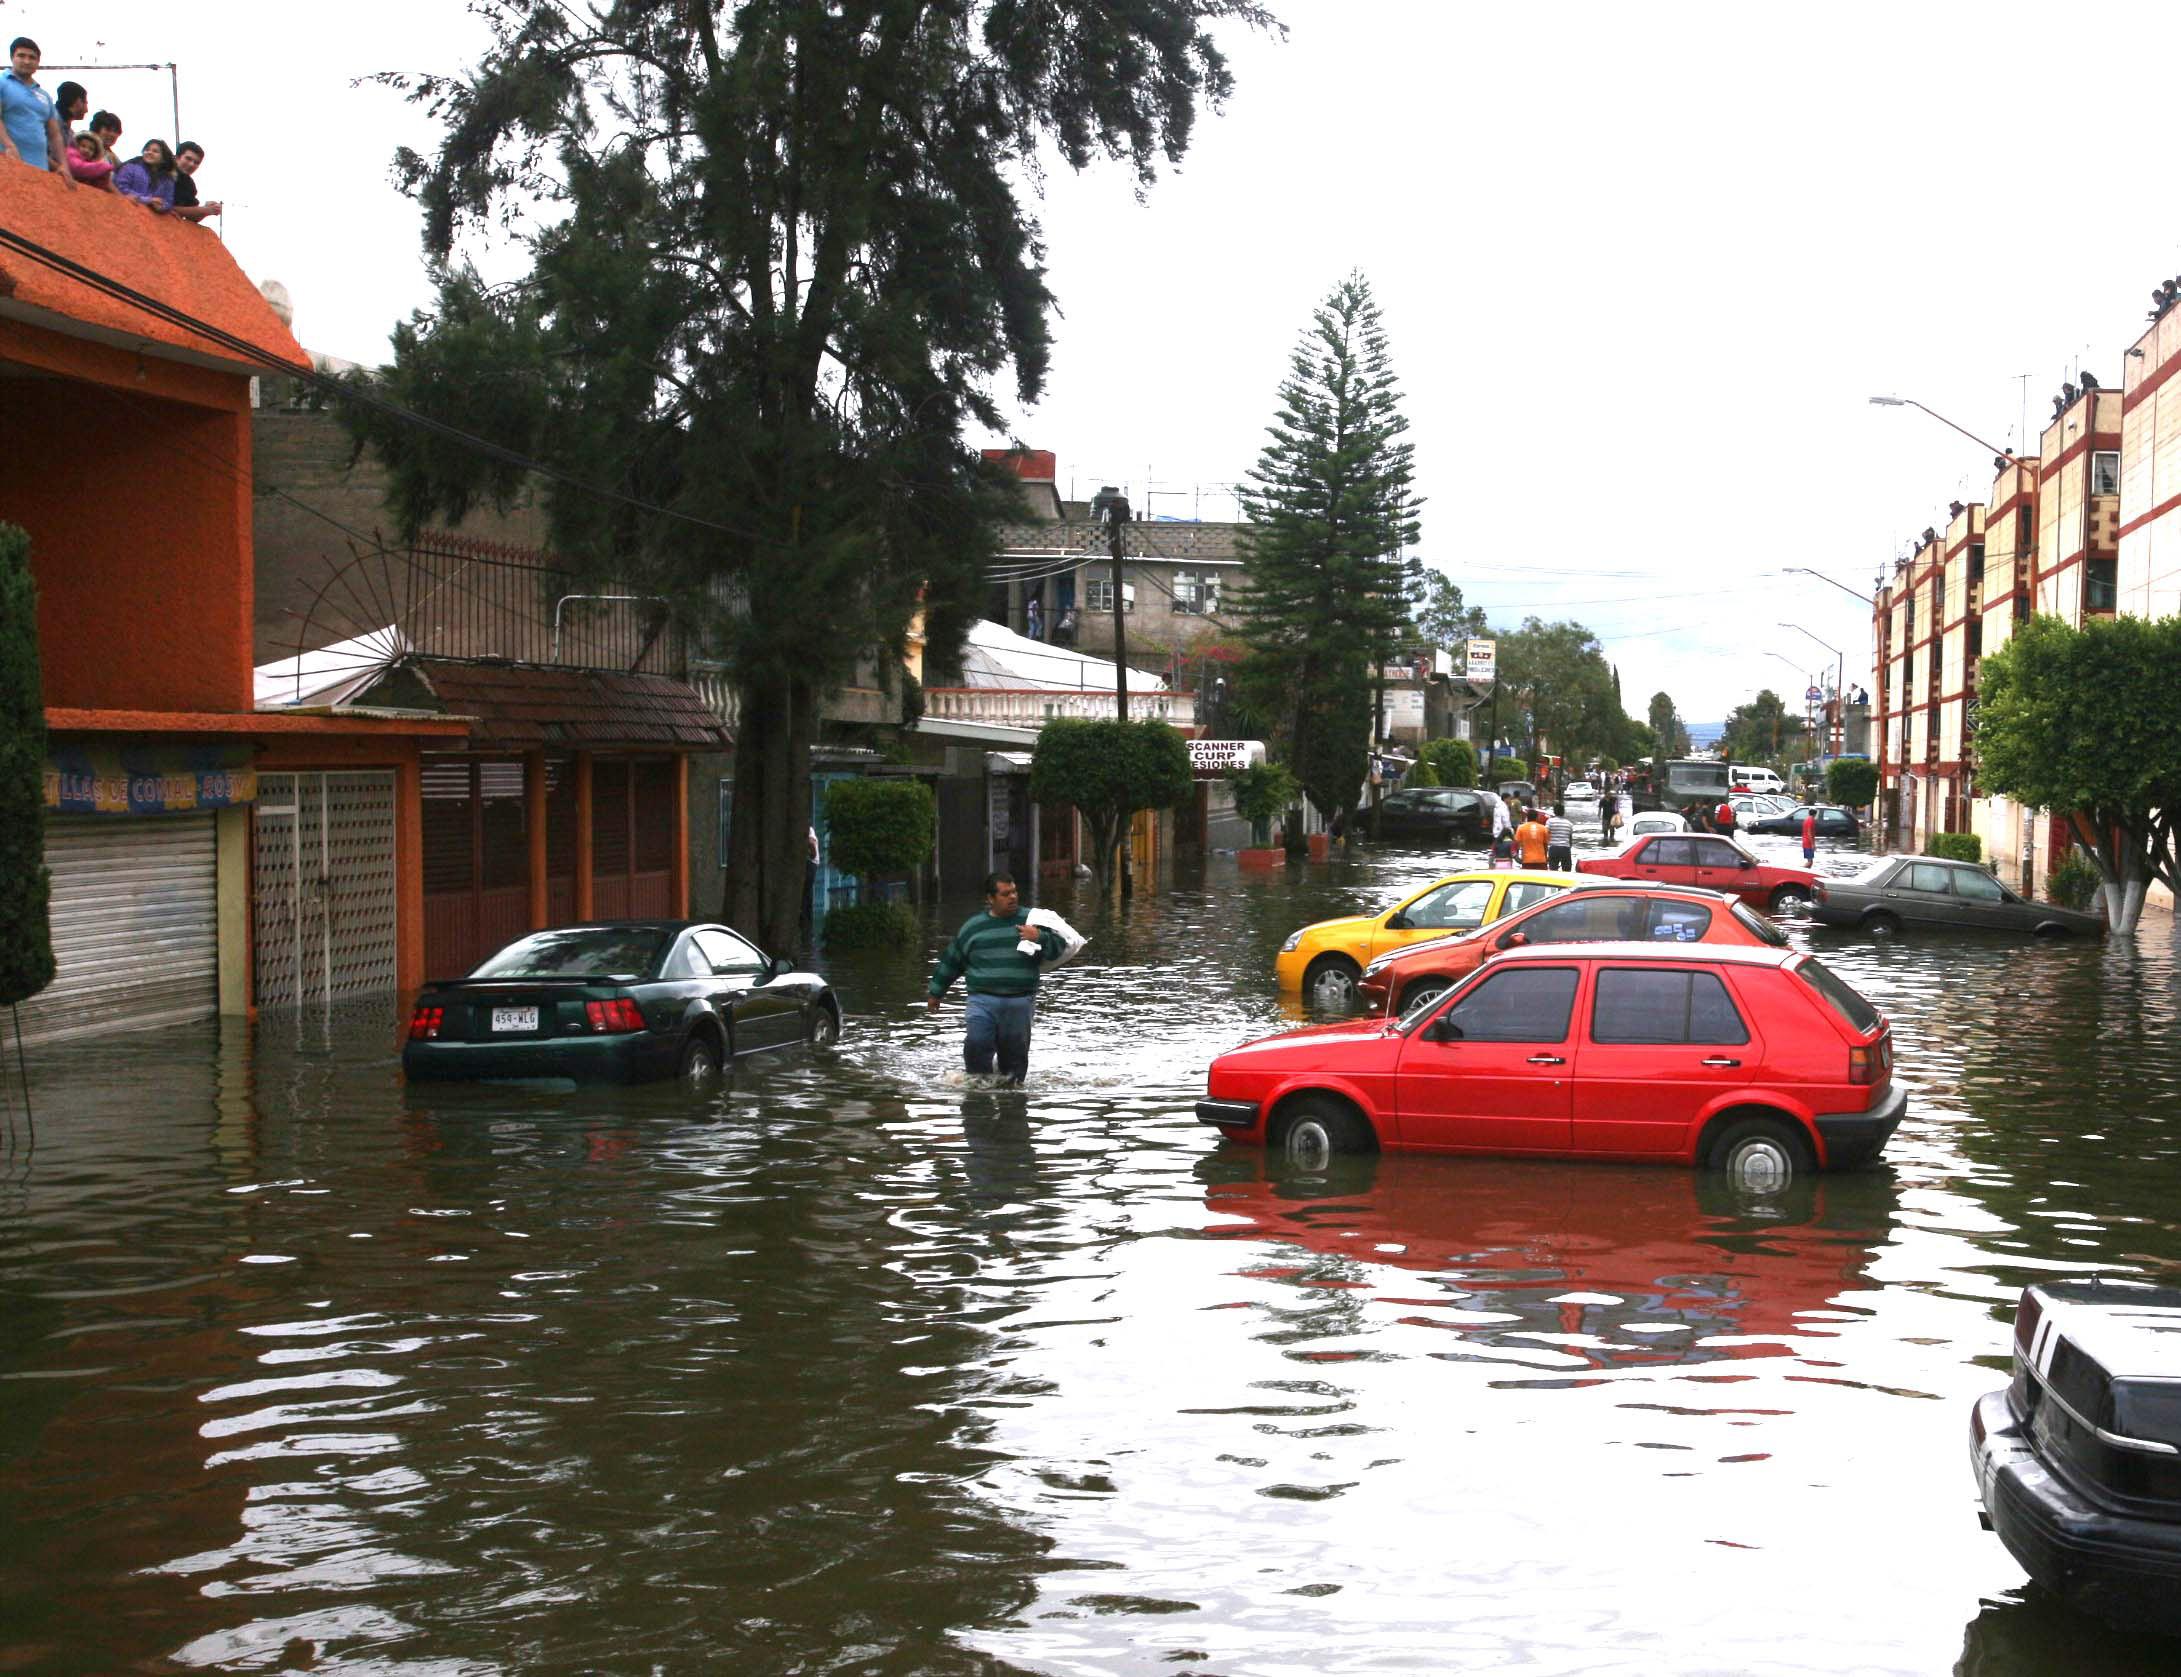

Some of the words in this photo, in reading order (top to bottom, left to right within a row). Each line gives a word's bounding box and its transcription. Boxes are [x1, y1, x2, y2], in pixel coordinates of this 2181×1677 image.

[1187, 742, 1245, 751] SCANNER
[1194, 751, 1236, 760] CURP
[108, 777, 129, 803] DE
